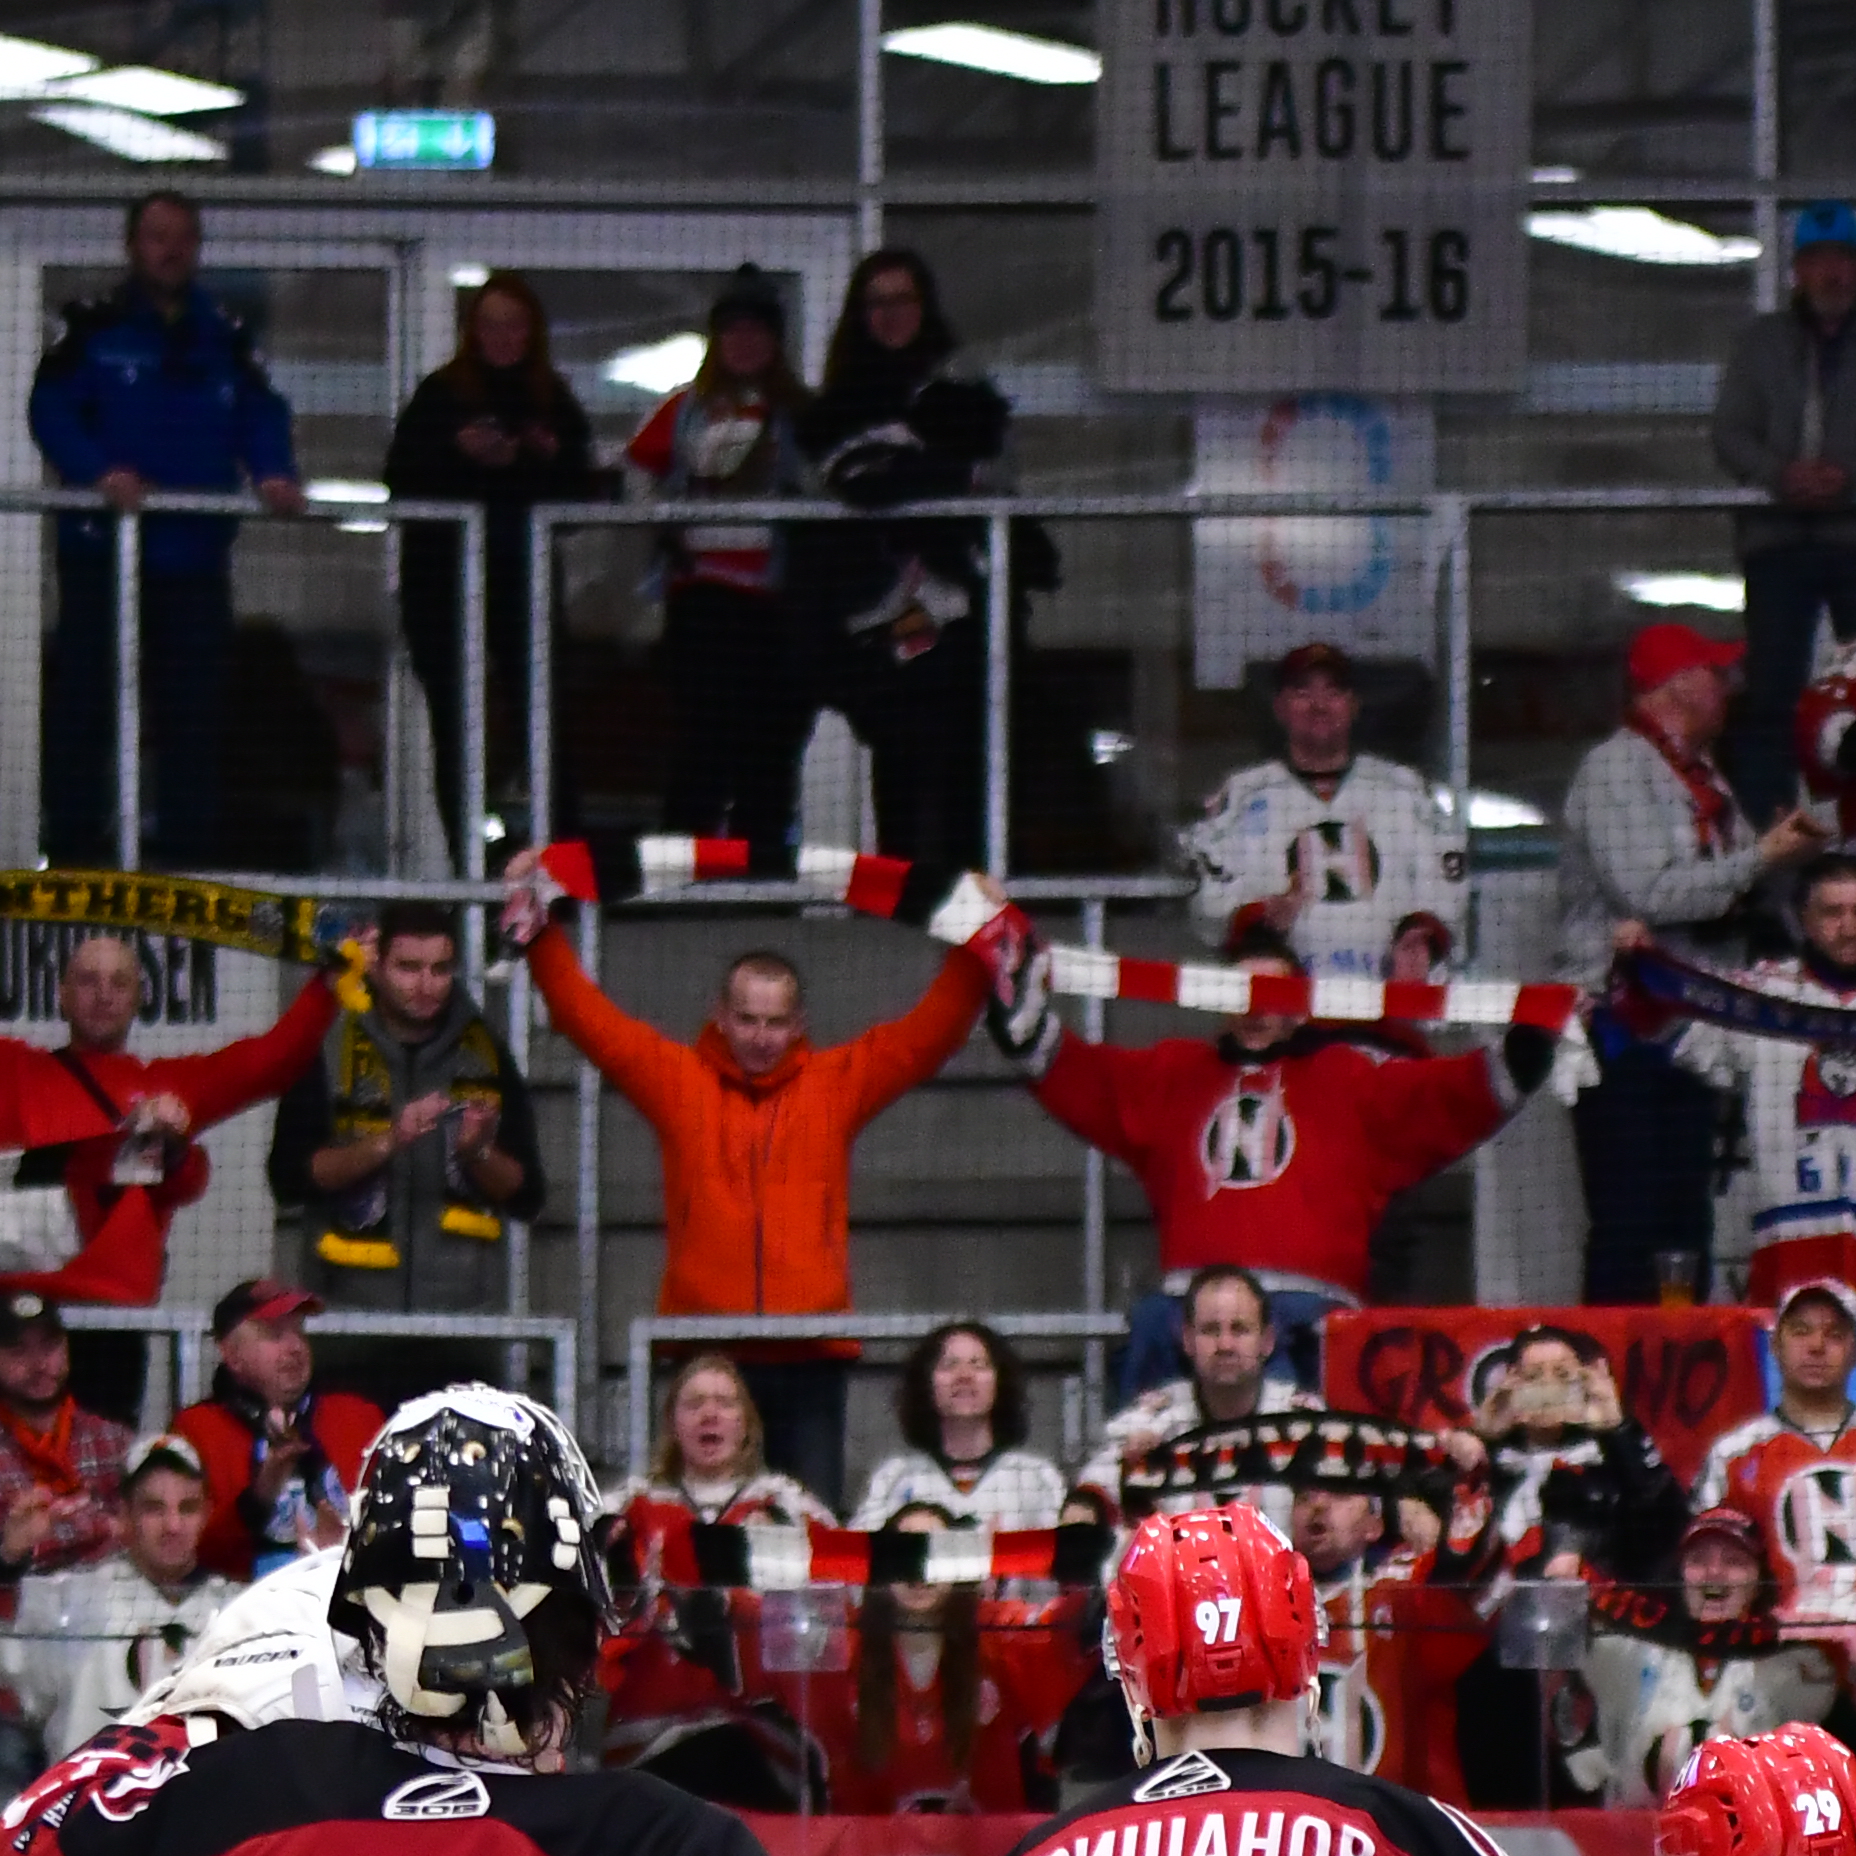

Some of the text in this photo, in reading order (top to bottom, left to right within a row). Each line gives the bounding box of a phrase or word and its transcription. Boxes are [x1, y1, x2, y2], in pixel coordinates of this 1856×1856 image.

[1154, 61, 1472, 161] LEAGUE
[1154, 228, 1472, 323] 2015-16
[1195, 1598, 1243, 1646] 97
[1795, 1790, 1842, 1835] 29
